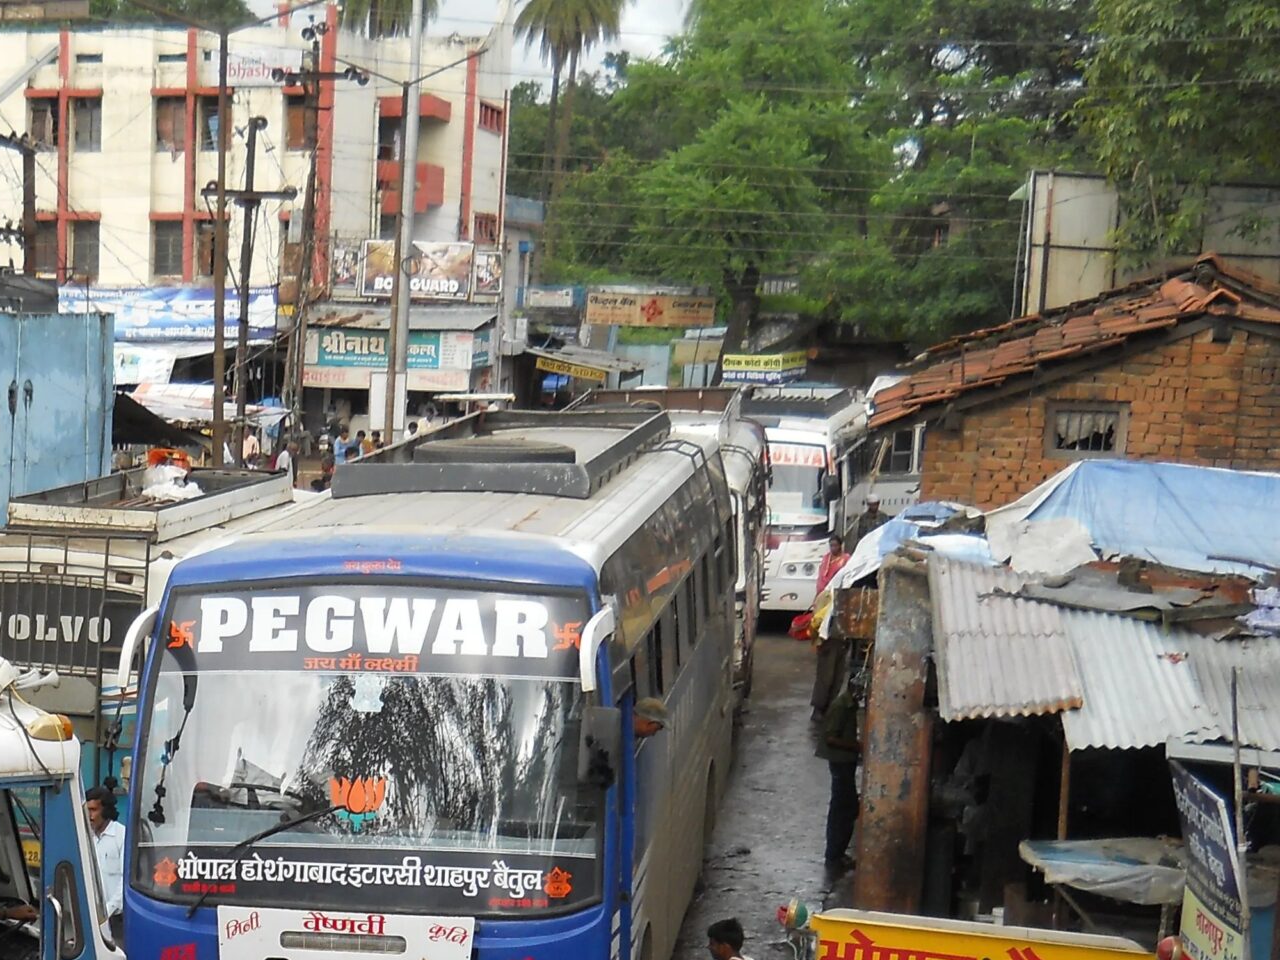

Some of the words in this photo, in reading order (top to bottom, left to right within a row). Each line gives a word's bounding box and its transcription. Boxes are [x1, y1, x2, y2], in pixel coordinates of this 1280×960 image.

[373, 276, 460, 293] BOGUARD
[198, 595, 549, 658] PEGWAR
[303, 656, 337, 670] जय
[177, 851, 237, 880] भोपाल
[240, 851, 347, 885] होशंगाबाद
[347, 856, 422, 888] इटारसी
[423, 865, 491, 897] शाहपुर
